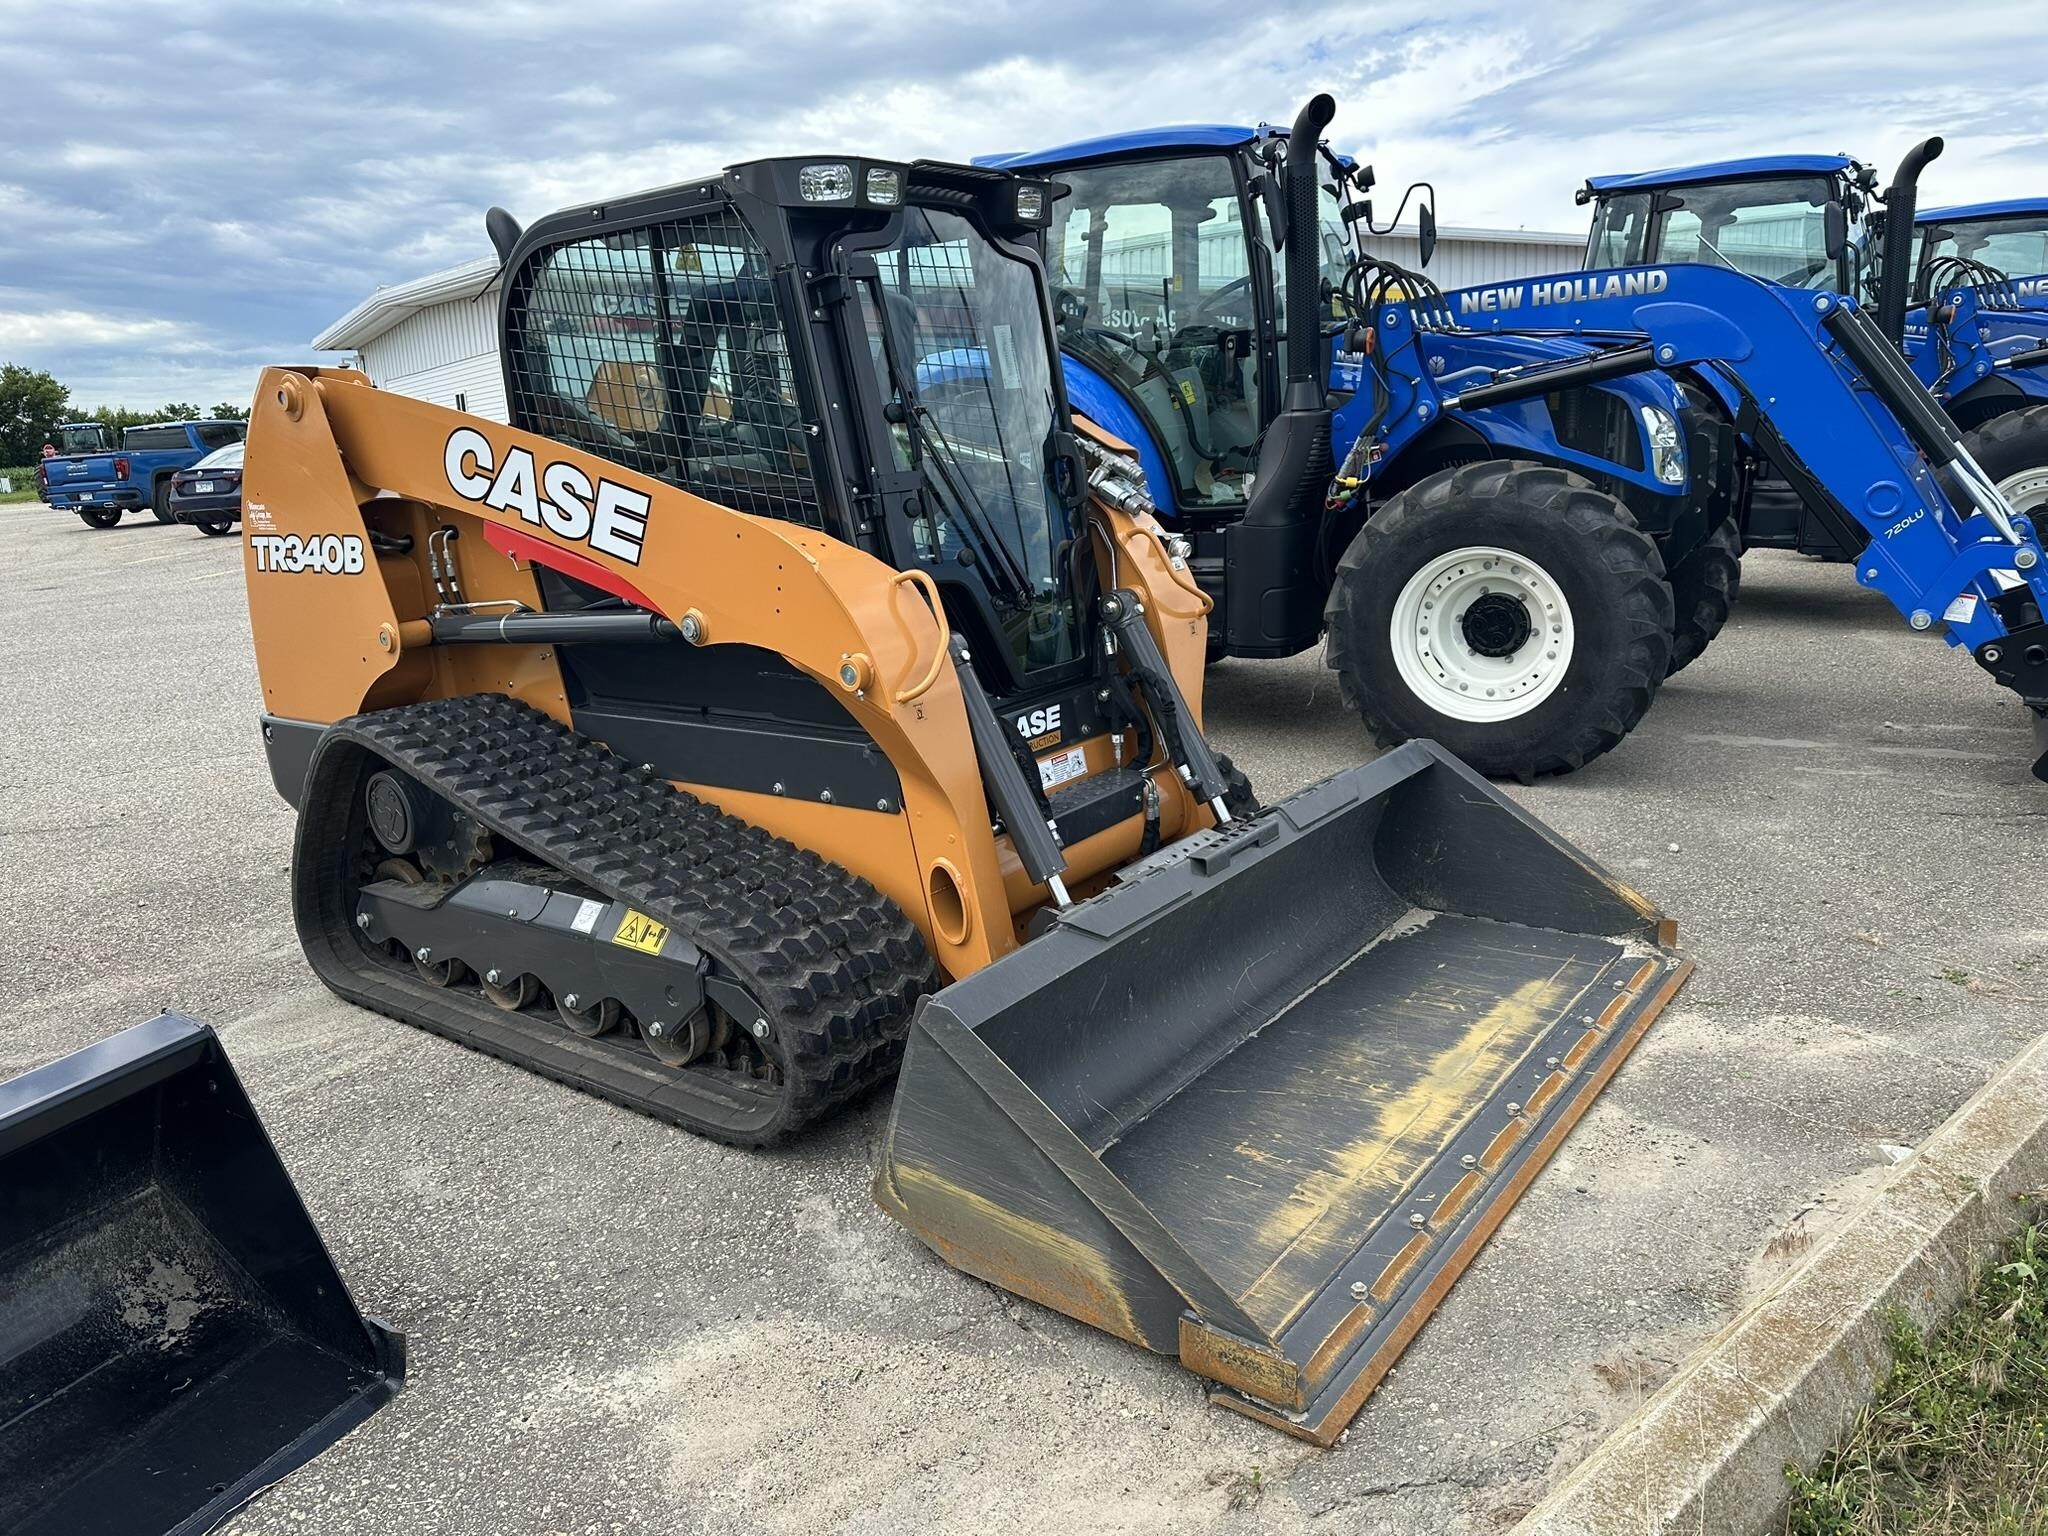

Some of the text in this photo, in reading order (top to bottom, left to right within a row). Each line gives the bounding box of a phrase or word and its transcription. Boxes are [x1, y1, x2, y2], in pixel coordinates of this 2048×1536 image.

[1461, 270, 1668, 314] NEW HOLLAND
[444, 427, 652, 566] CASE
[1884, 509, 1924, 540] 720LU
[251, 534, 364, 574] TR340B
